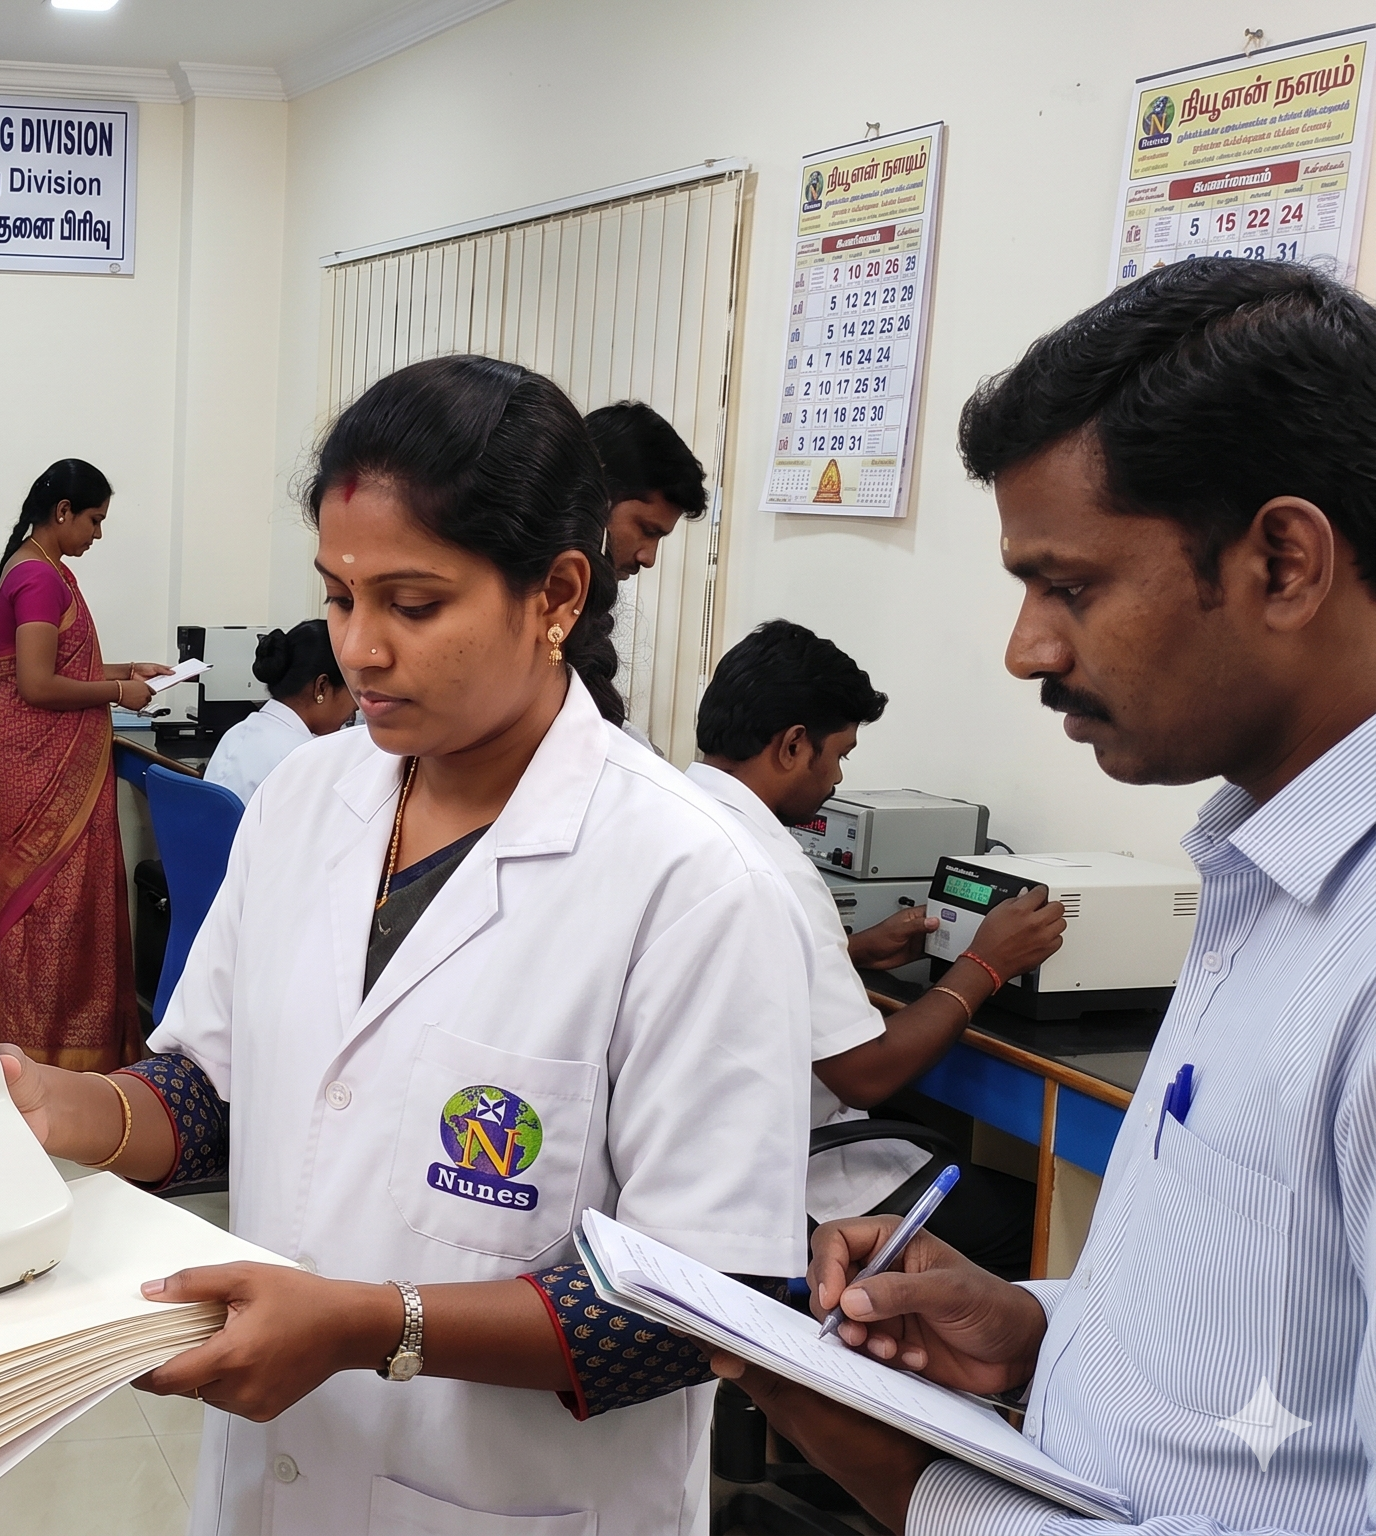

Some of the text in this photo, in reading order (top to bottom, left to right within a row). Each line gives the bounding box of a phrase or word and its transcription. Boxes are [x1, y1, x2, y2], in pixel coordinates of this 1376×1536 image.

[21, 118, 113, 157] DIVISION
[10, 167, 102, 196] Division
[1189, 203, 1304, 237] 5 15 22 24
[848, 264, 862, 280] 10
[866, 261, 881, 278] 20
[884, 258, 900, 275] 26
[830, 295, 837, 311] 5
[845, 292, 859, 309] 12
[863, 290, 877, 307] 21
[826, 314, 910, 340] 5 14 22 25 26
[806, 346, 891, 368] 4 7 16 24 24
[803, 376, 887, 396] 2 10 17 25 31
[800, 409, 808, 424] 3
[816, 407, 828, 423] 11
[833, 406, 847, 422] 18
[870, 405, 884, 421] 30
[797, 436, 805, 451] 3
[812, 436, 826, 451] 12
[849, 435, 862, 451] 31
[455, 1117, 523, 1178] N
[434, 1167, 530, 1207] Nunes
